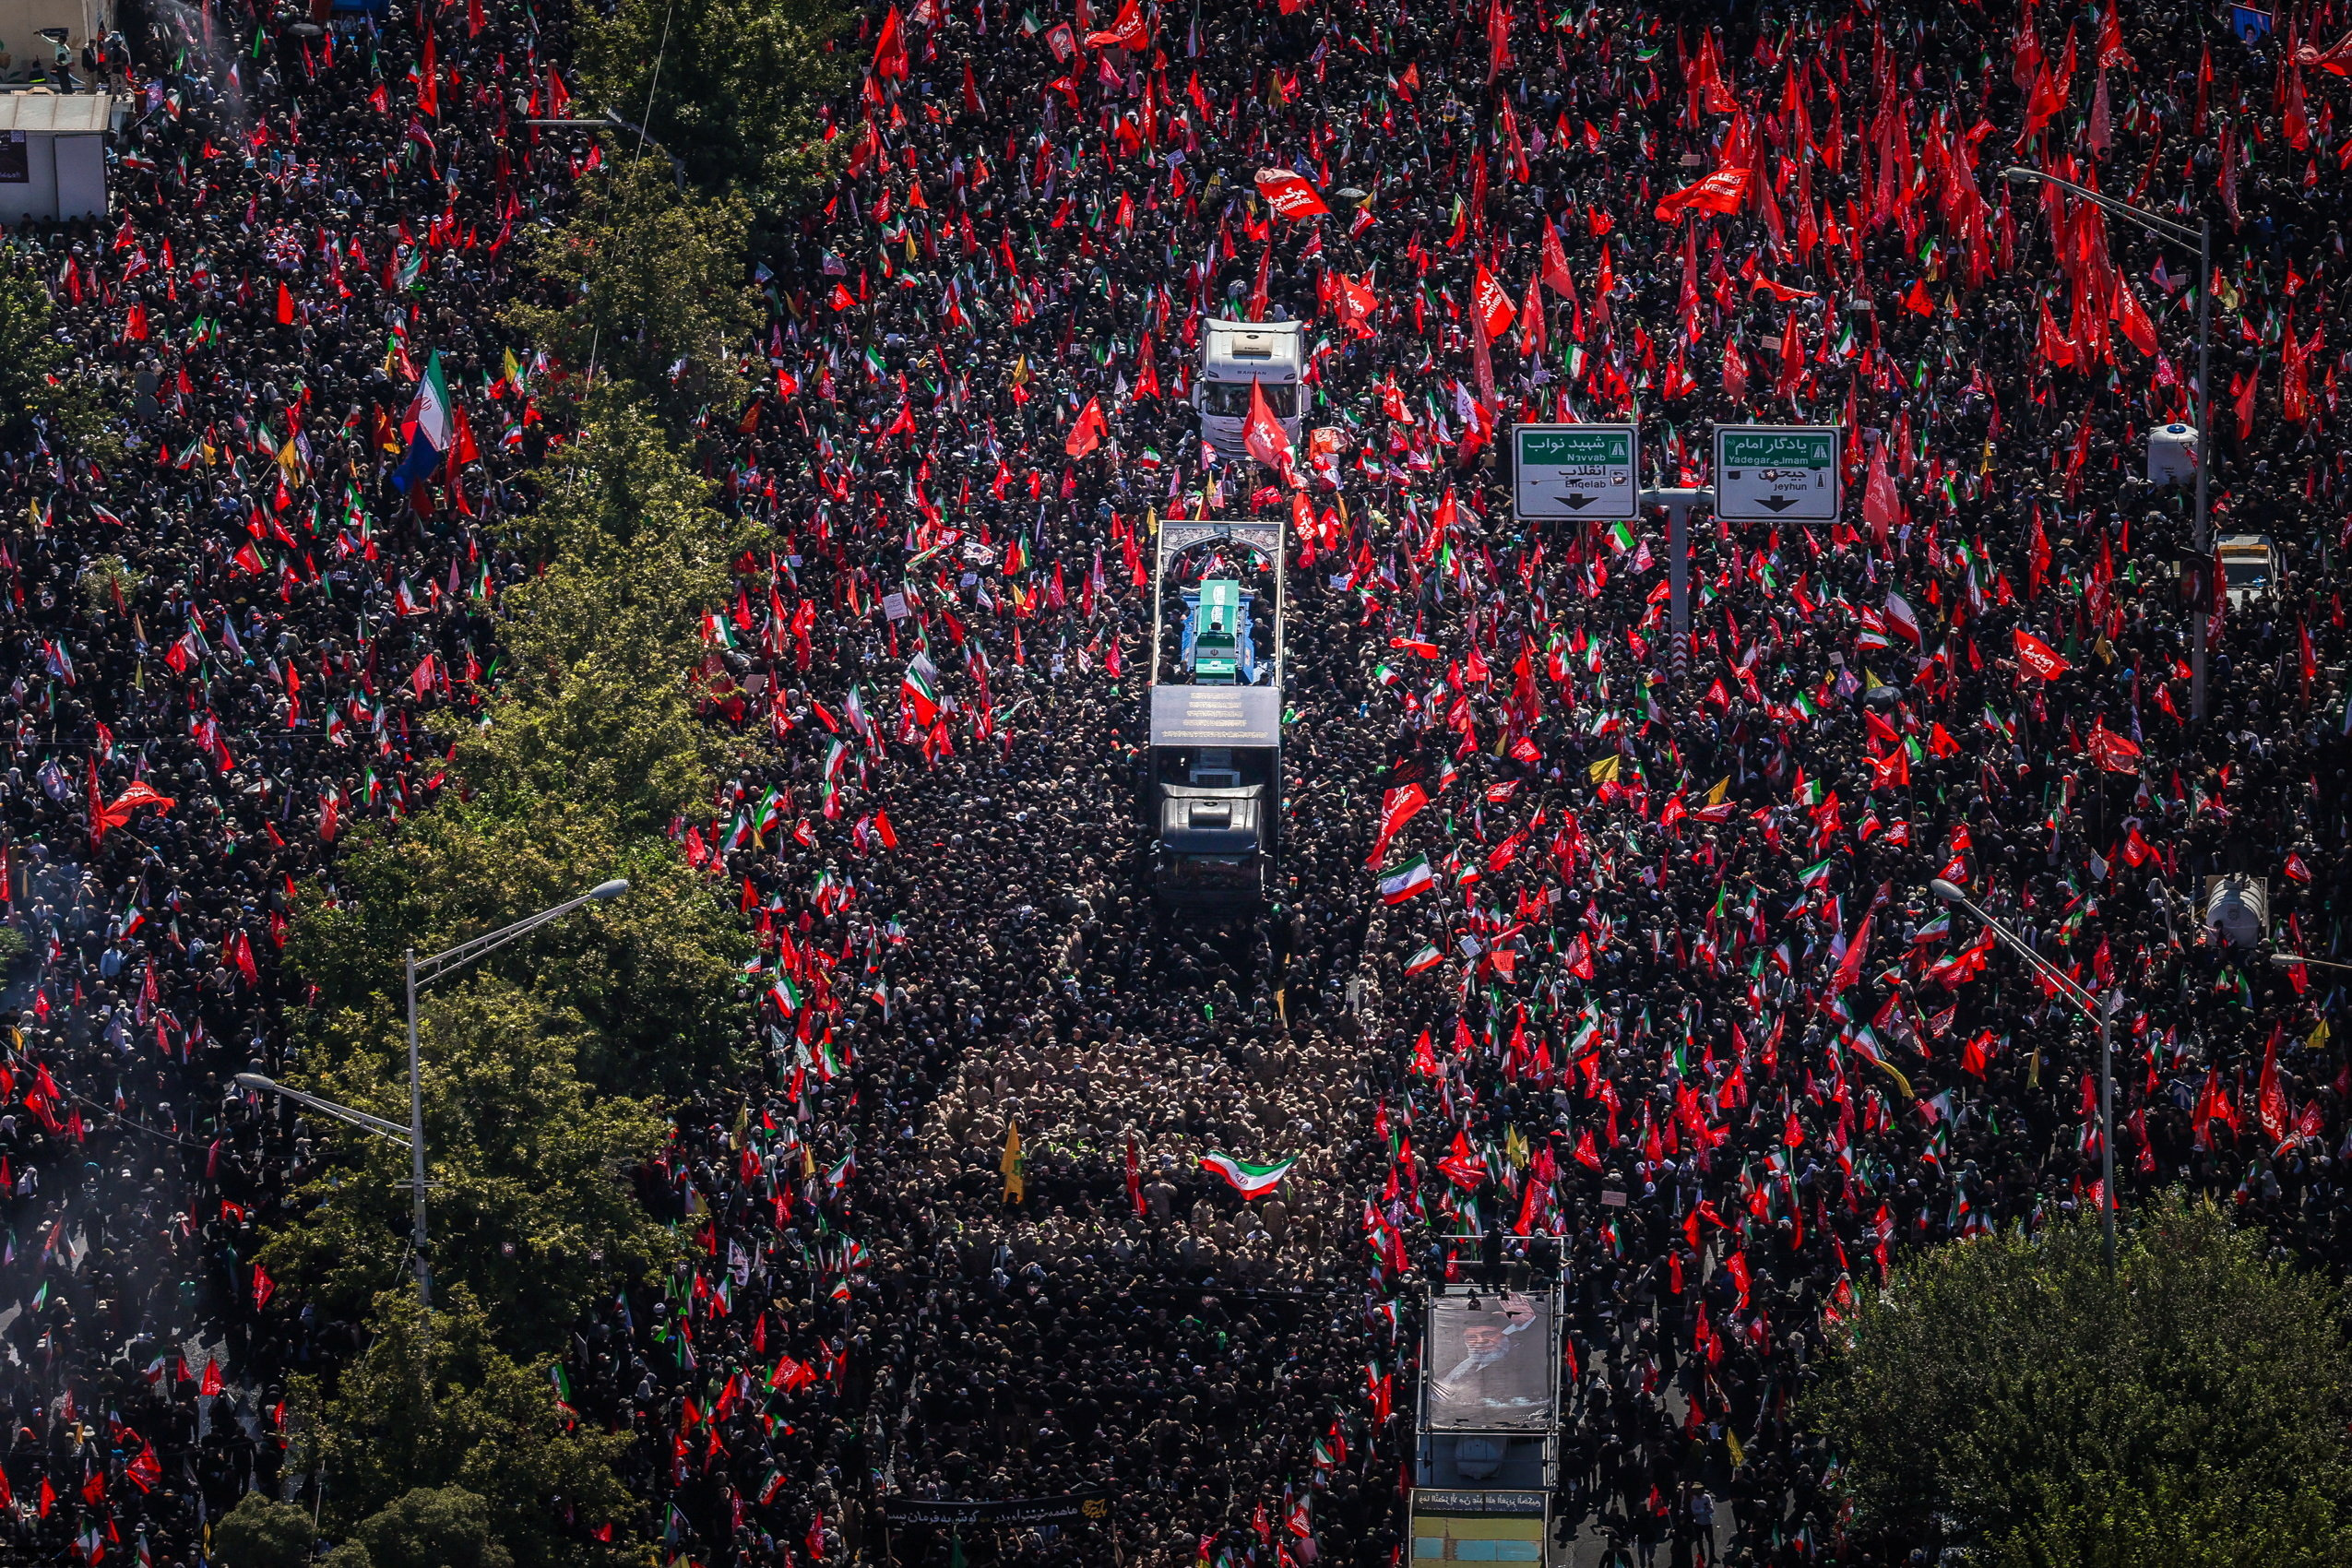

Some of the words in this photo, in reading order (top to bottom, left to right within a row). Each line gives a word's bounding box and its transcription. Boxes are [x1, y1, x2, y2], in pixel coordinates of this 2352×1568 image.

[1526, 437, 1565, 454] نواب
[1568, 435, 1606, 451] شهید
[1735, 438, 1764, 456] امام
[1765, 437, 1807, 454] یادگار
[1567, 453, 1606, 462] Navvab
[1558, 465, 1607, 480] انقلاب
[1758, 469, 1807, 481] جیحن
[1565, 480, 1607, 490] Enqelab
[907, 1510, 941, 1526] فرمان
